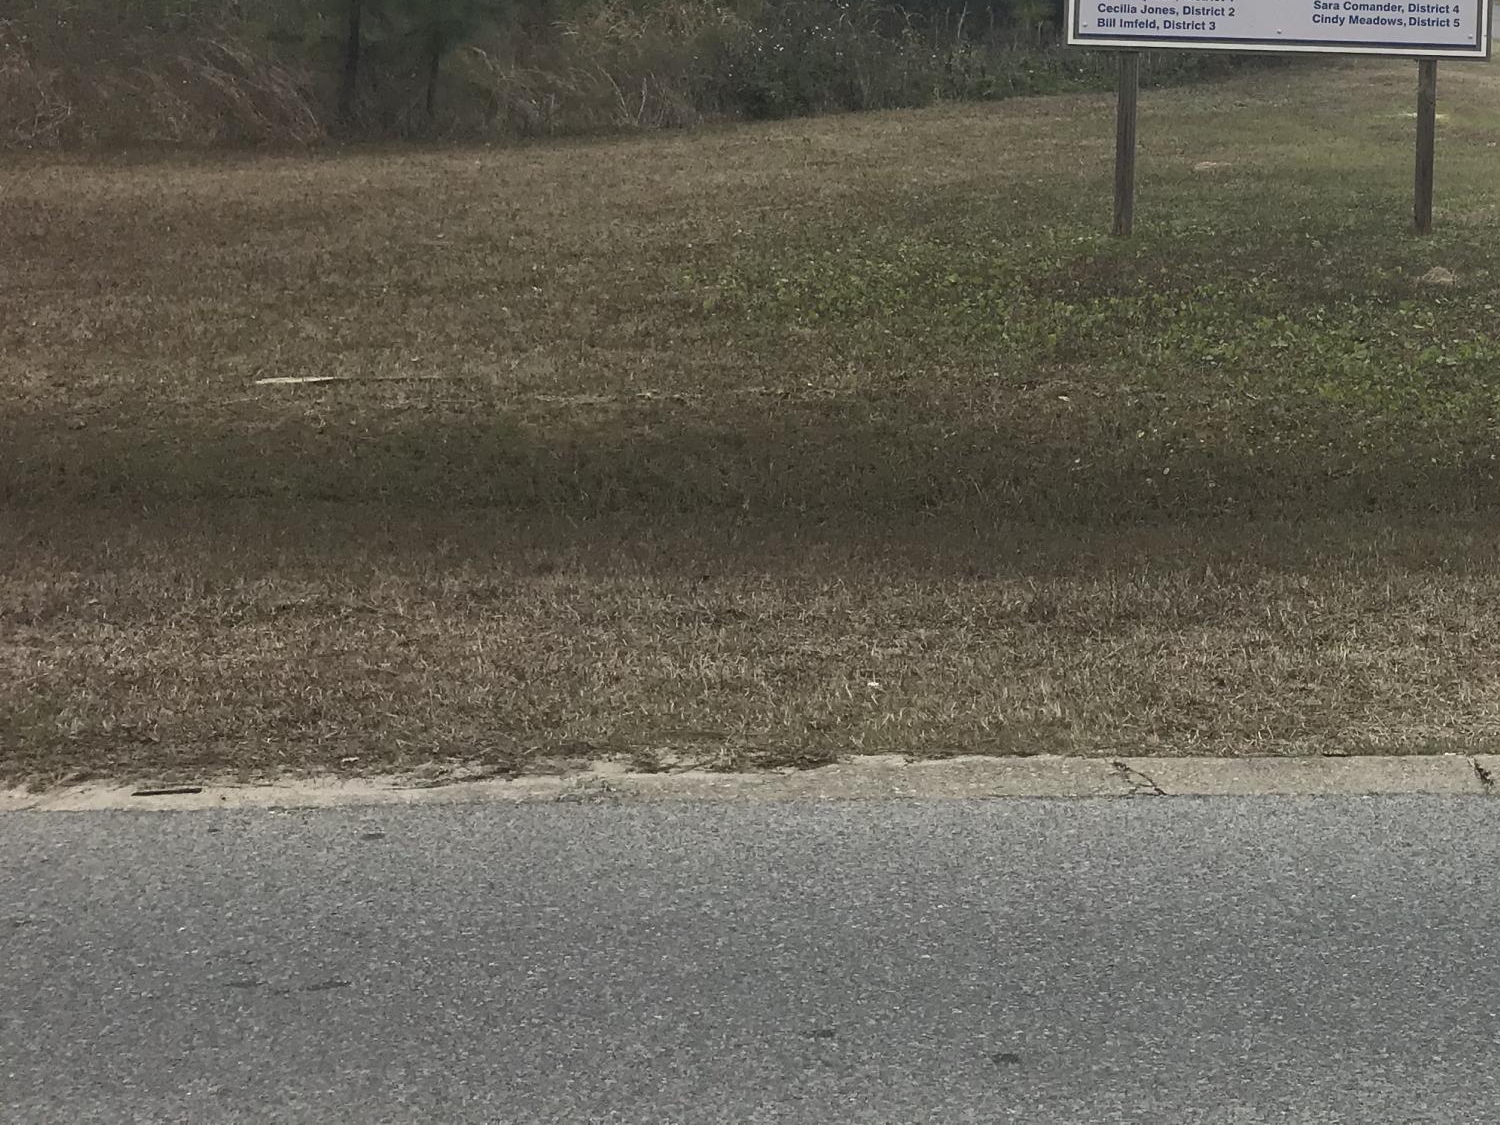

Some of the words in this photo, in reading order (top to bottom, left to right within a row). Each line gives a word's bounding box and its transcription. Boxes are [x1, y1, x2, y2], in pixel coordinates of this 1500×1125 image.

[1097, 3, 1137, 14] Cecilia
[1140, 5, 1179, 17] Jones,
[1182, 6, 1225, 17] District
[1227, 7, 1236, 17] 2
[1313, 0, 1340, 11] Sara
[1343, 1, 1405, 14] Comander,
[1408, 3, 1450, 14] District
[1452, 5, 1460, 14] 4
[1097, 18, 1117, 29] Bill
[1119, 19, 1160, 32] Imfeld,
[1163, 20, 1206, 31] District
[1208, 22, 1217, 31] 3
[1312, 14, 1346, 27] Cindy
[1348, 15, 1407, 28] Meadows,
[1408, 17, 1451, 28] District
[1452, 19, 1461, 28] 5
